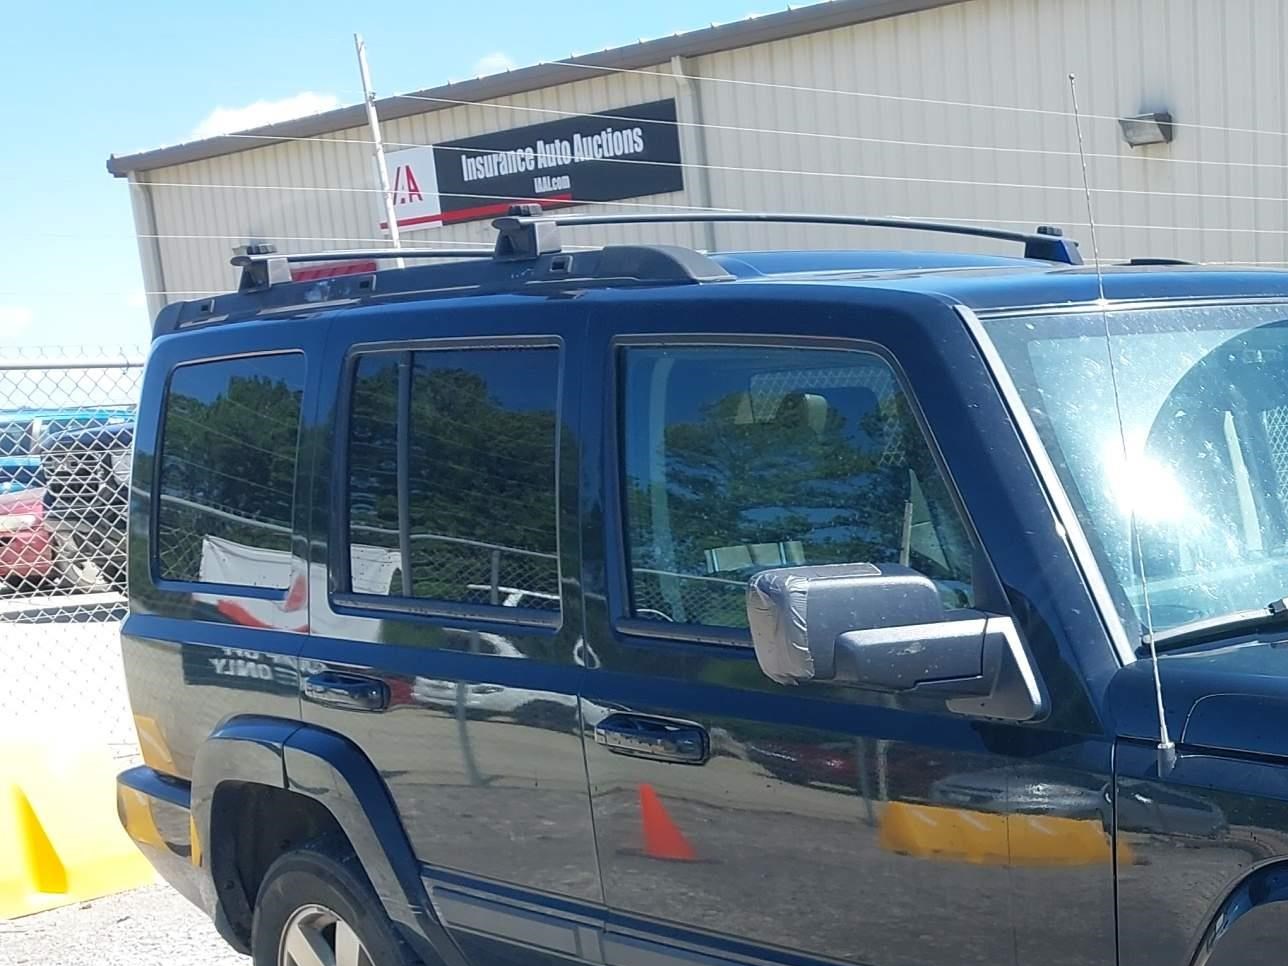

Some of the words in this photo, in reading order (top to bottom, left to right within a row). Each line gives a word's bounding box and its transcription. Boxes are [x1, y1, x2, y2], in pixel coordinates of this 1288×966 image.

[461, 147, 535, 182] Insurance
[536, 139, 572, 169] Auto
[573, 127, 644, 163] Auctions
